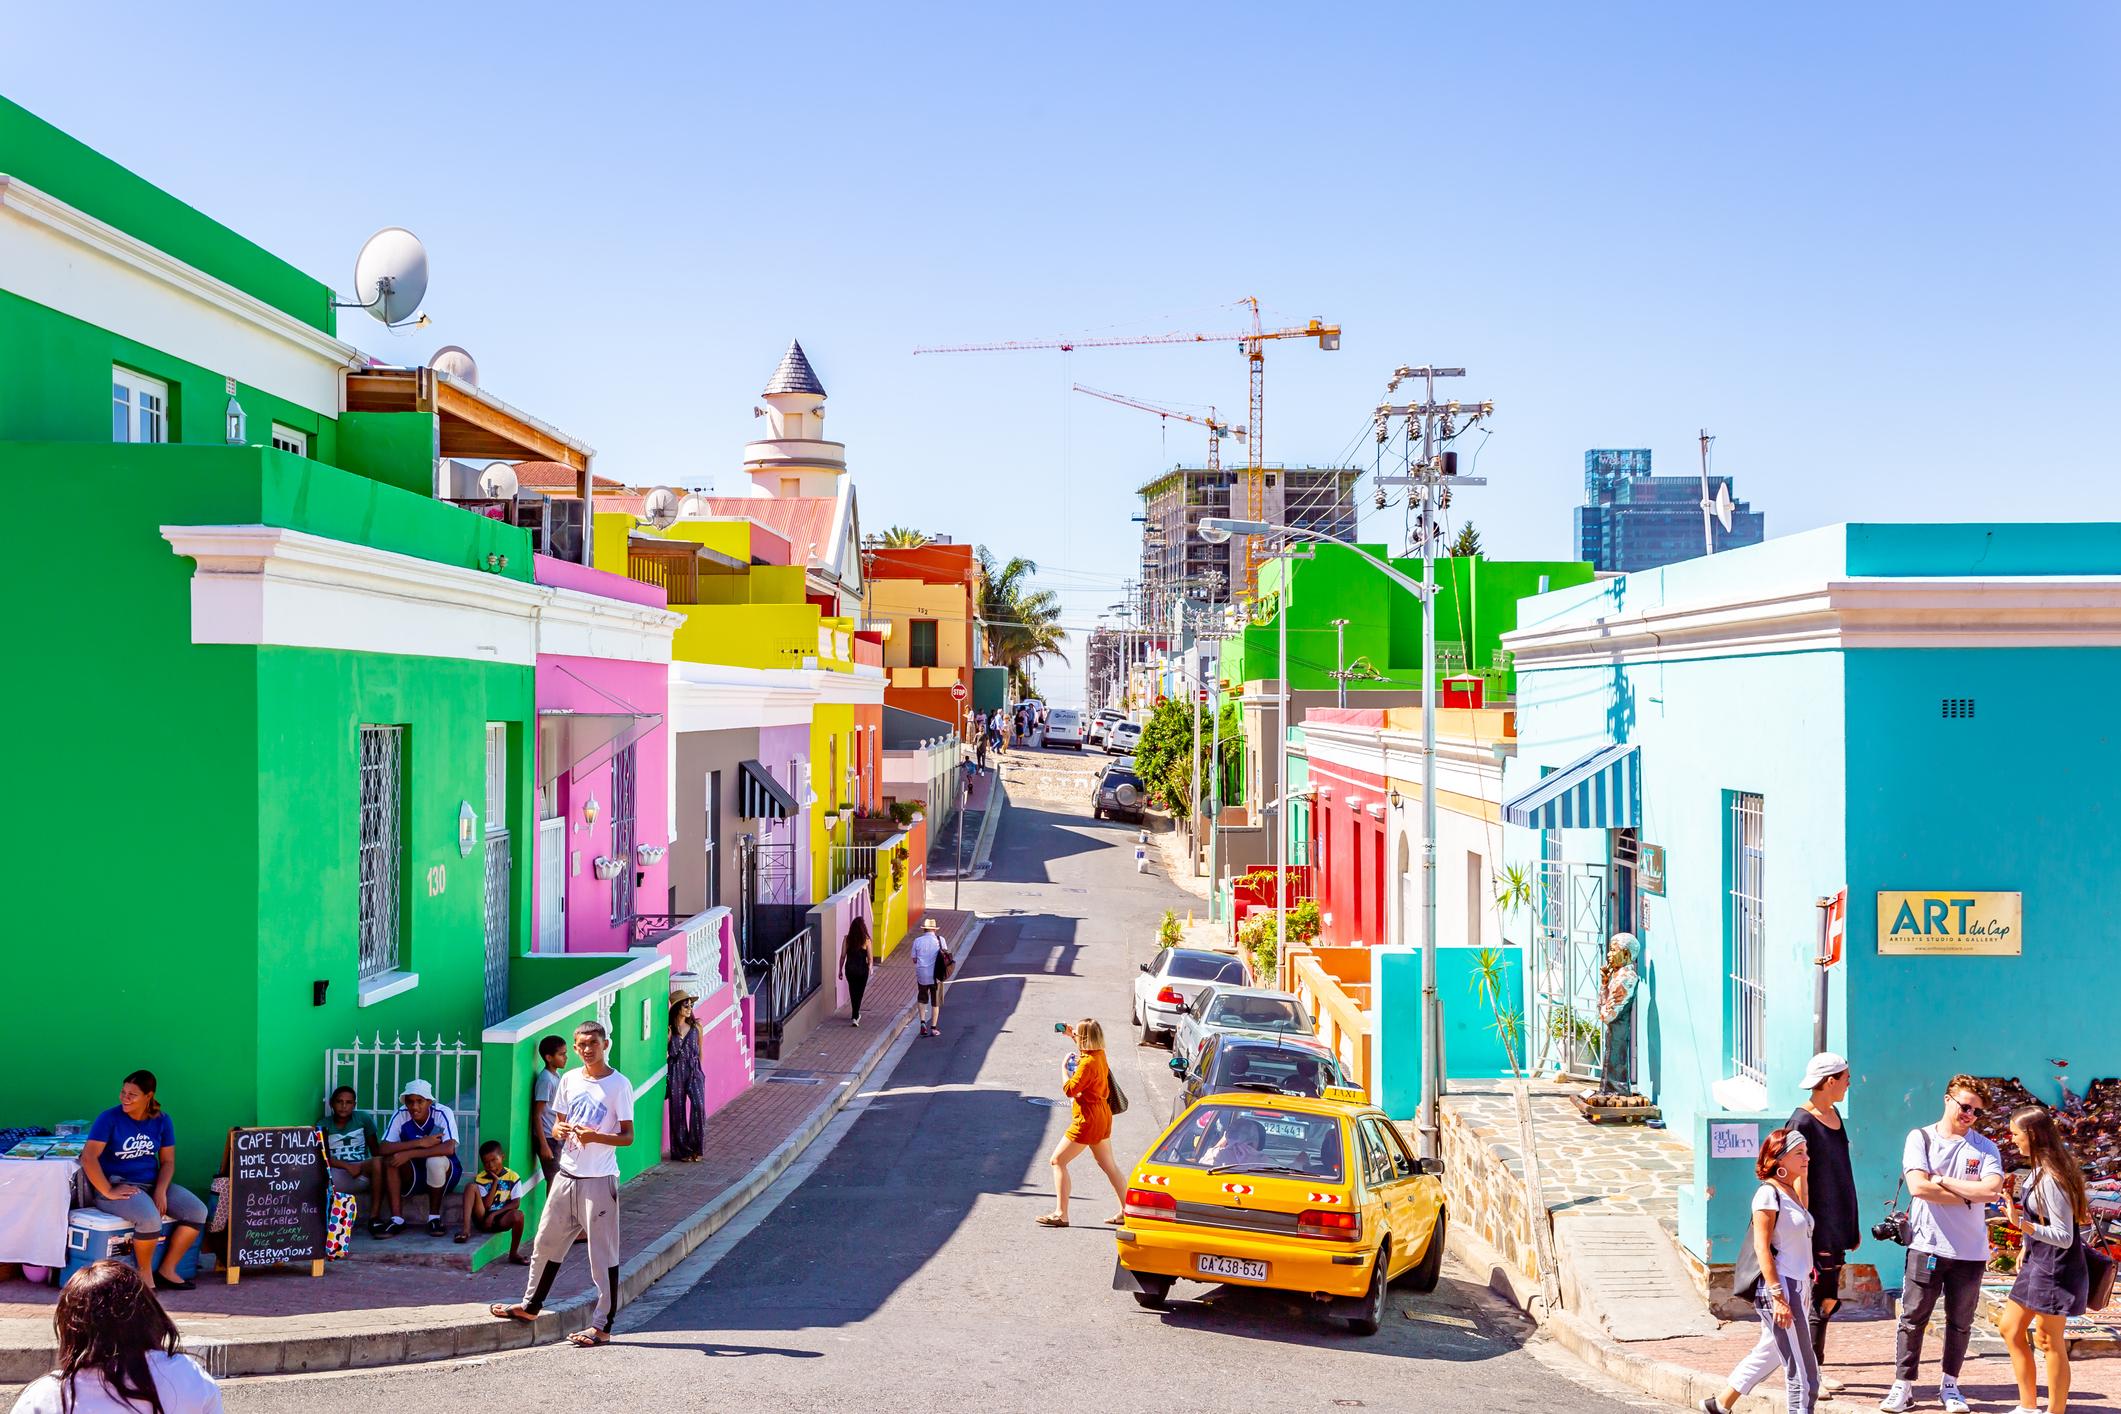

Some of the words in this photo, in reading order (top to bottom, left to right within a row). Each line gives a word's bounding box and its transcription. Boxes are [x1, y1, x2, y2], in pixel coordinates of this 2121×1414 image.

[953, 688, 966, 696] STOP
[426, 864, 447, 897] 130
[1889, 898, 1976, 935] ART
[1969, 919, 1986, 936] du
[1987, 919, 2010, 940] Cap
[1332, 1088, 1357, 1098] TAXI
[122, 1136, 155, 1151] Cape
[238, 1133, 273, 1150] CAPE
[240, 1154, 266, 1166] HOME
[271, 1153, 316, 1166] COOKED
[240, 1166, 281, 1179] MEALS
[1201, 1256, 1214, 1271] CA
[1218, 1259, 1264, 1278] 438-634
